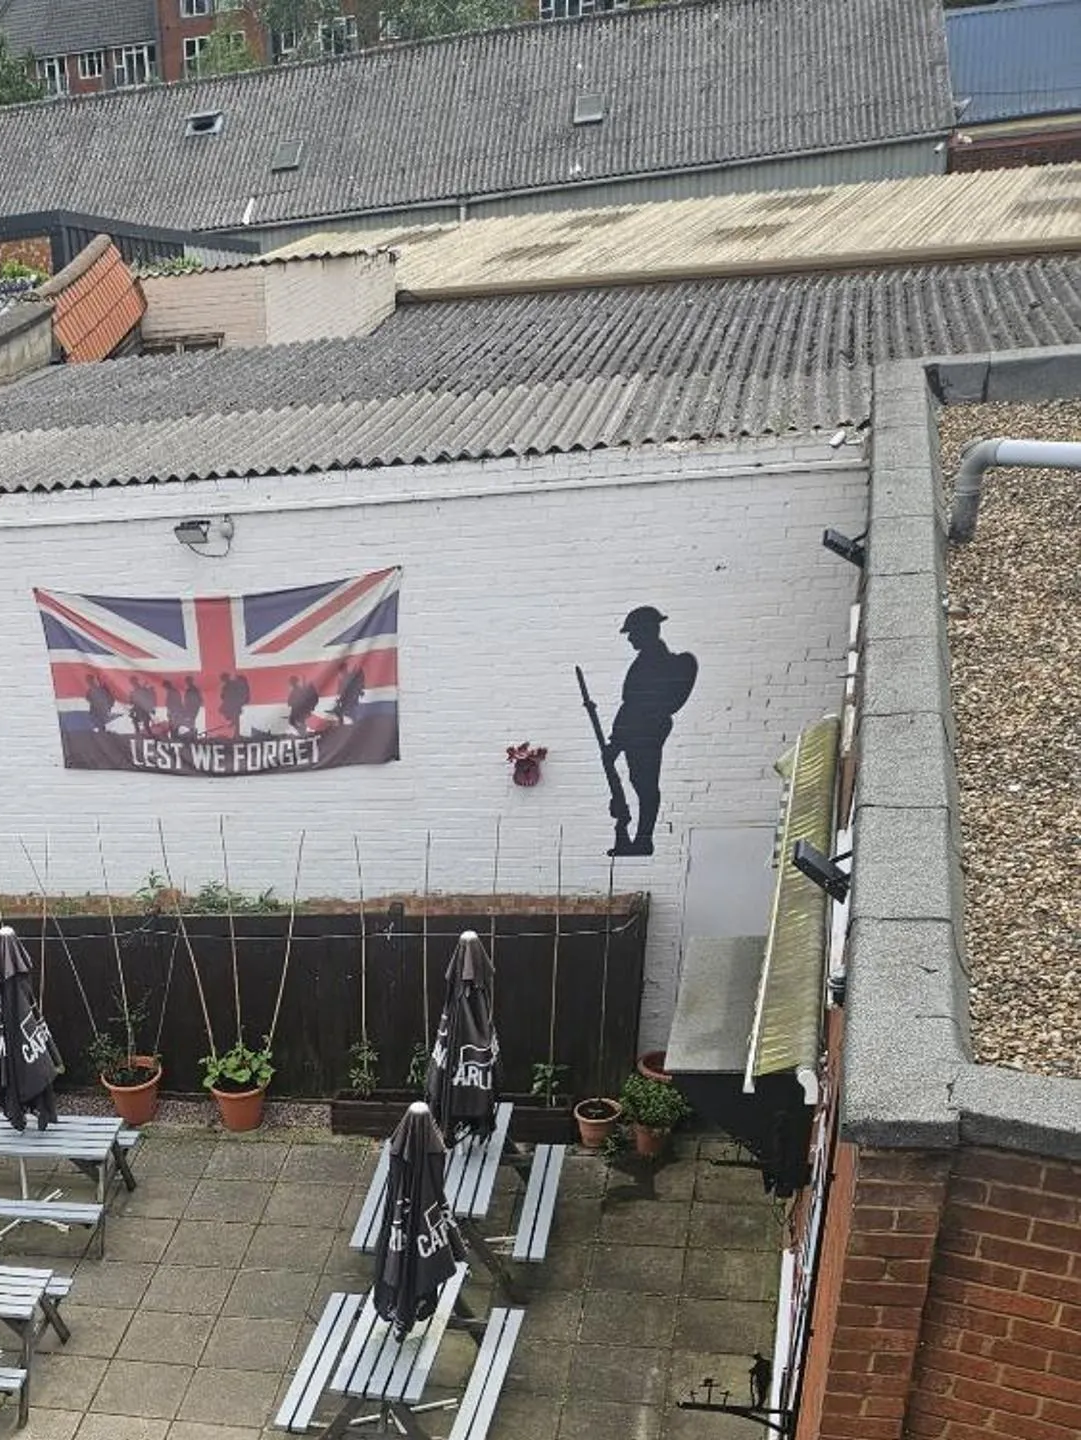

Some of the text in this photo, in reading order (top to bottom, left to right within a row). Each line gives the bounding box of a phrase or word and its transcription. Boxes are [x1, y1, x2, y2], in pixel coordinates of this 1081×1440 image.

[130, 735, 321, 772] LEST WE FORGET
